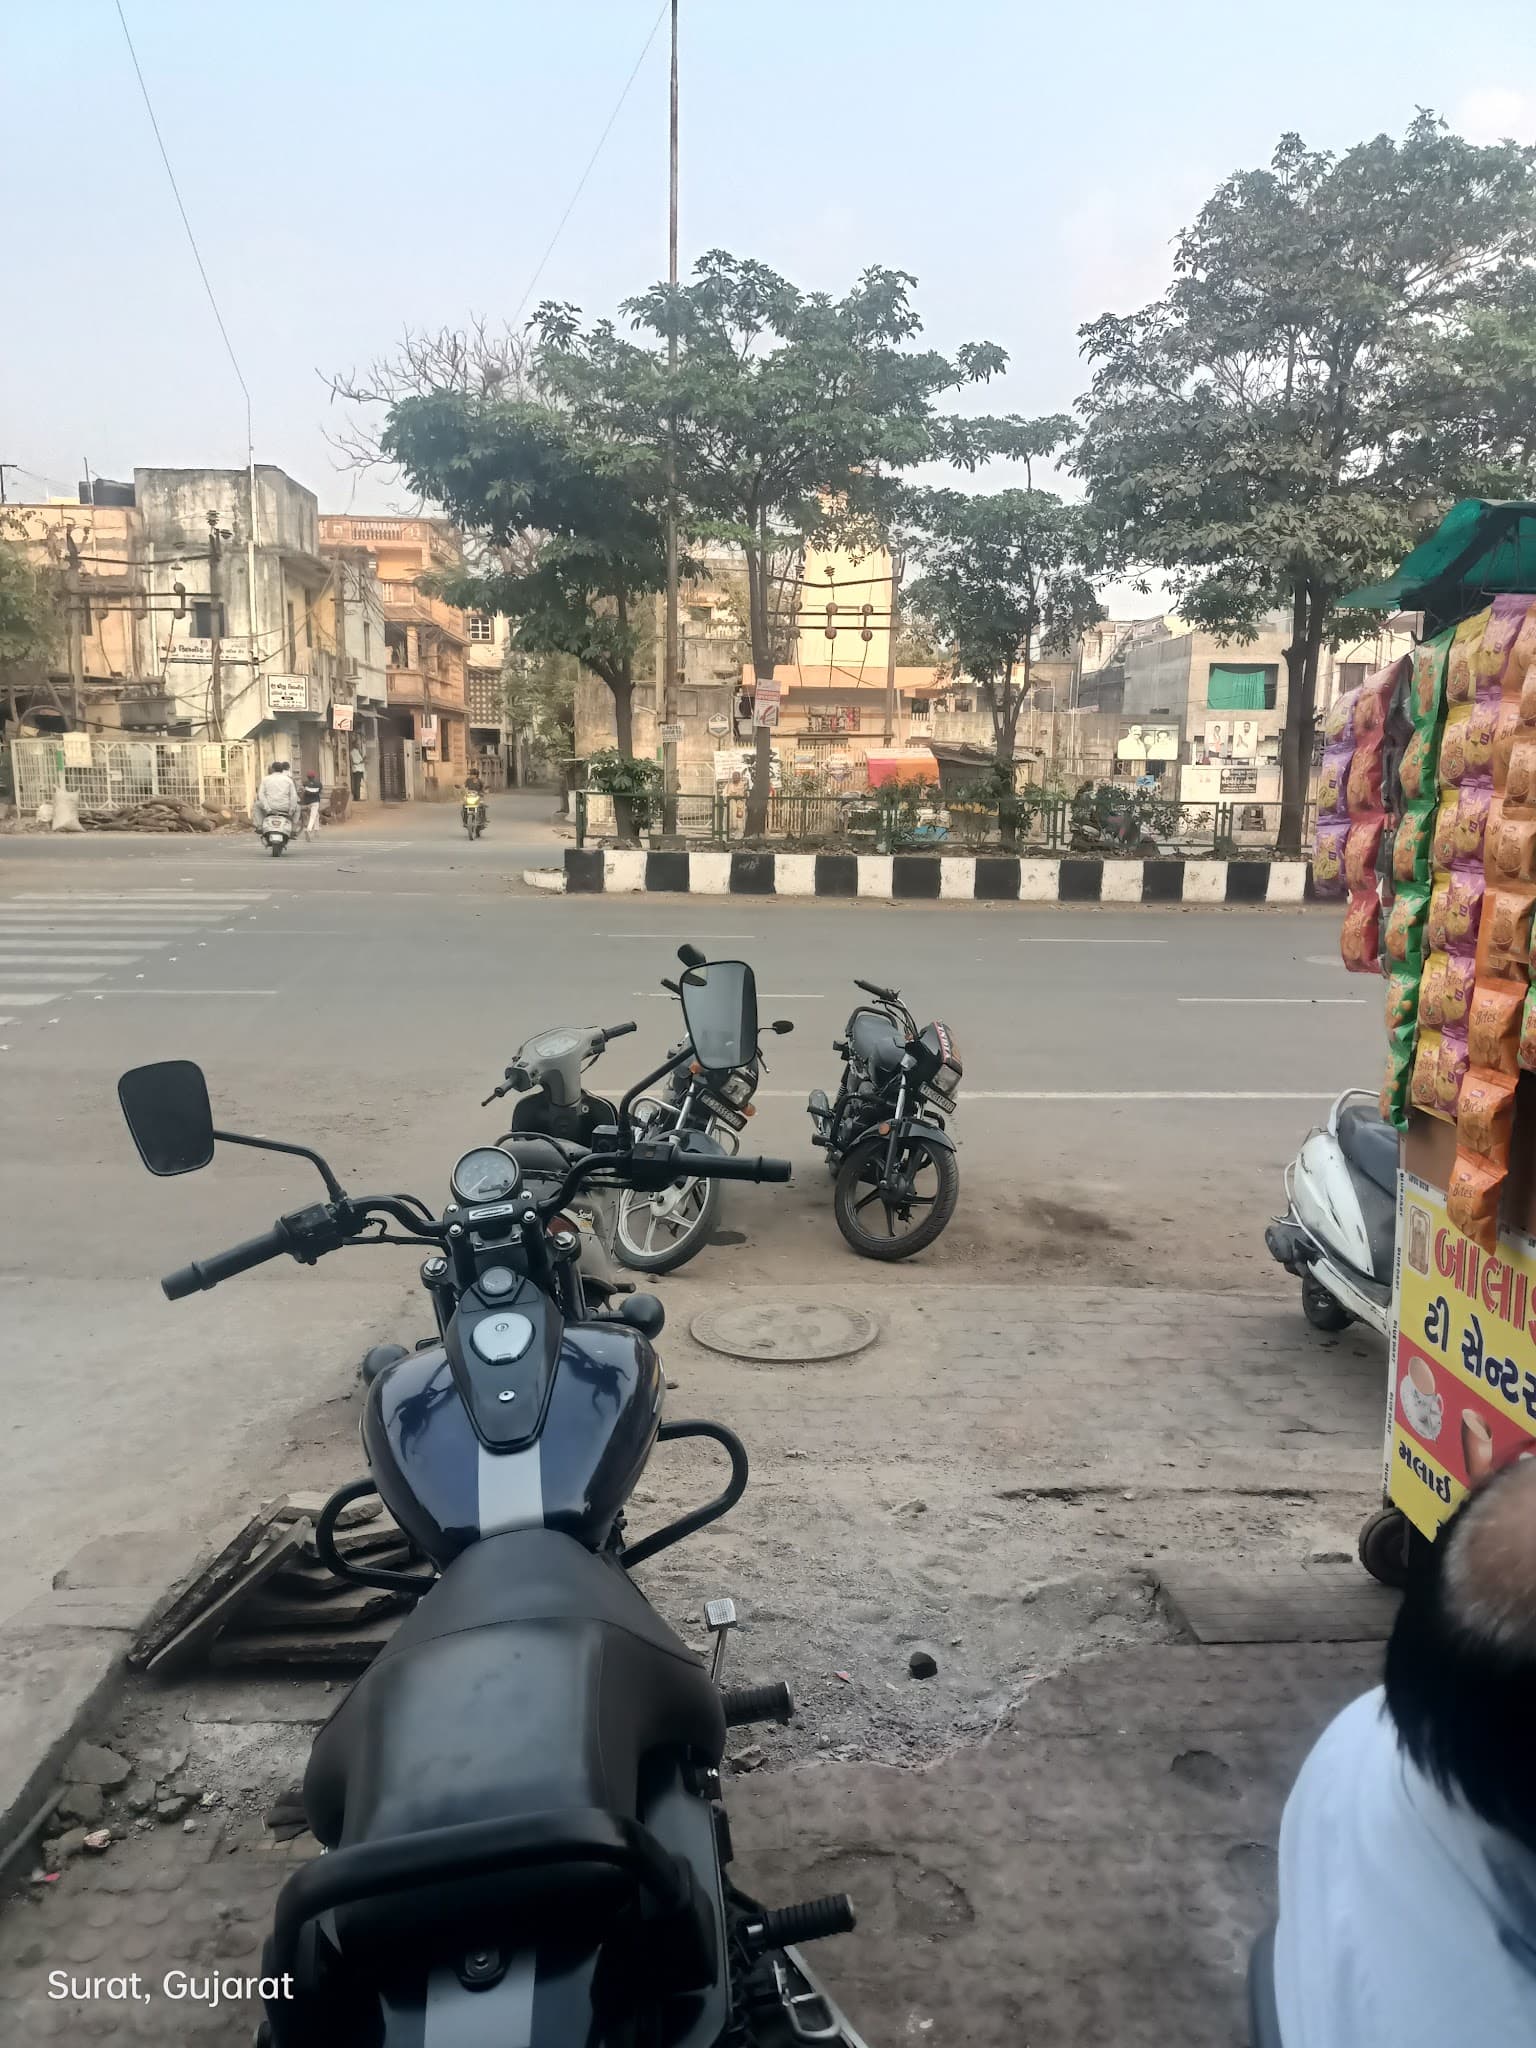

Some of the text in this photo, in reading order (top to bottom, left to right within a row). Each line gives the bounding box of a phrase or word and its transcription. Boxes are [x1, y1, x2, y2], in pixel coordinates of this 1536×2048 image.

[1434, 1227, 1536, 1346] બાલા
[1424, 1296, 1450, 1353] ટી
[1398, 1439, 1452, 1504] મલાઈ
